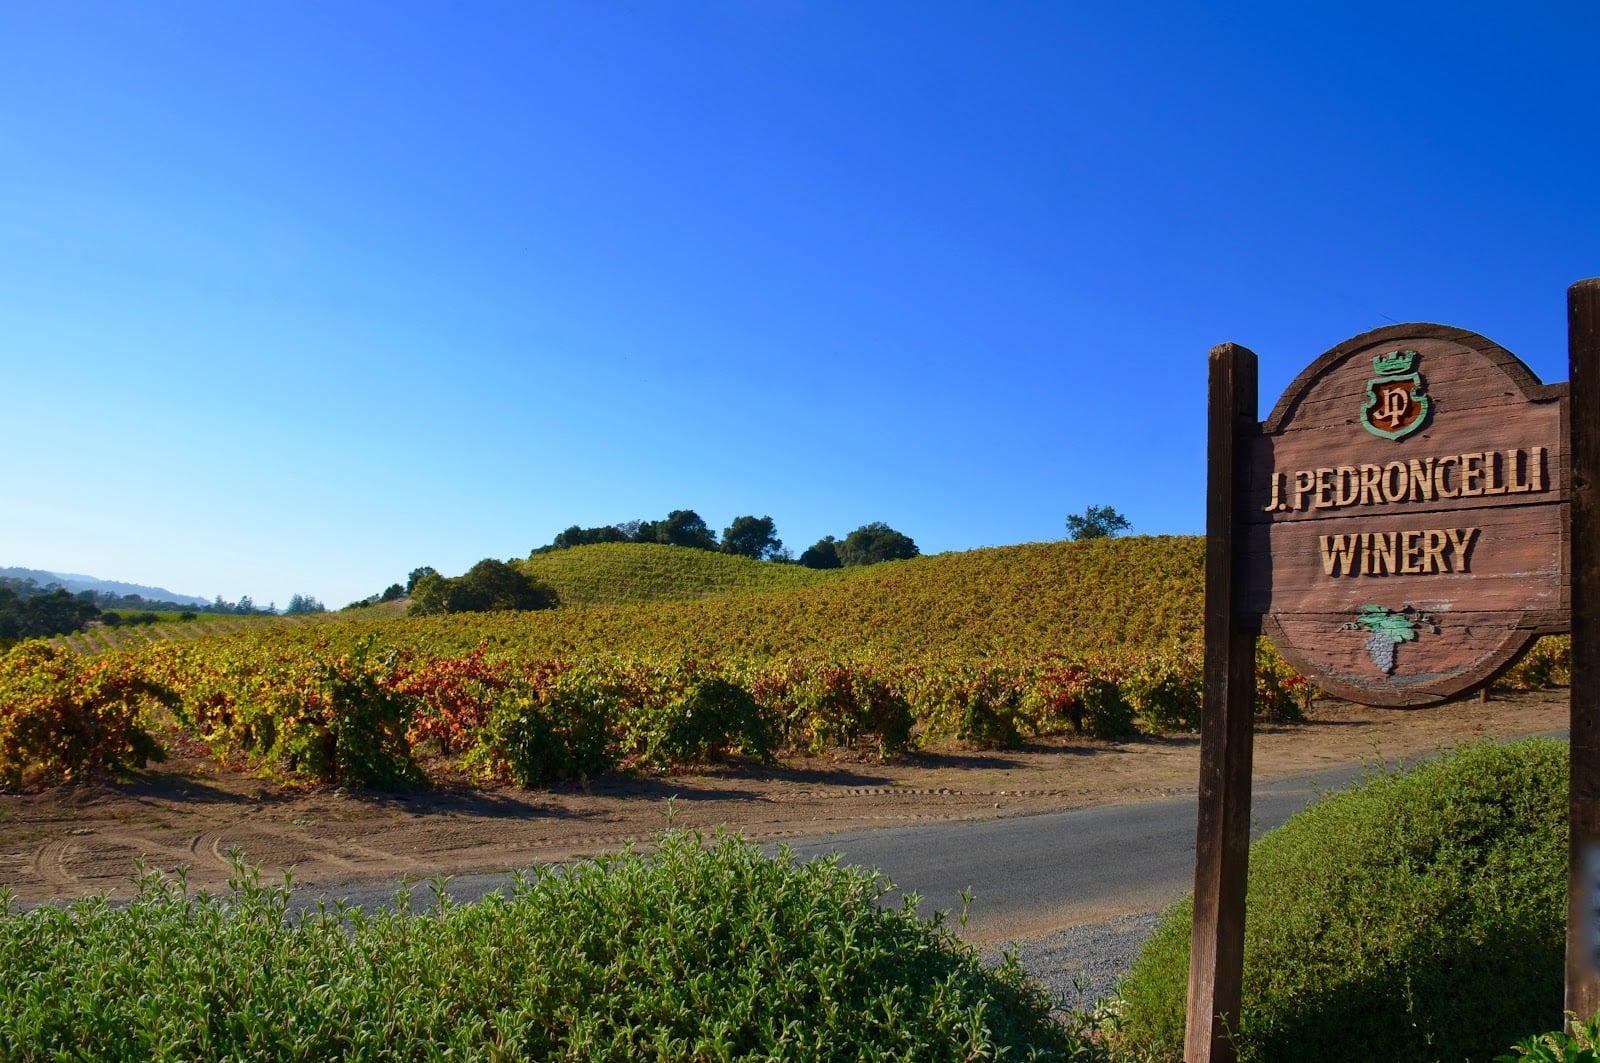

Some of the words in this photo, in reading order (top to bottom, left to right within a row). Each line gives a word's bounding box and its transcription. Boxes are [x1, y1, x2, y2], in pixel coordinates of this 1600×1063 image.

[1265, 472, 1287, 512] J.
[1295, 447, 1542, 510] PEDRONCELLI
[1319, 527, 1477, 576] WINERY
